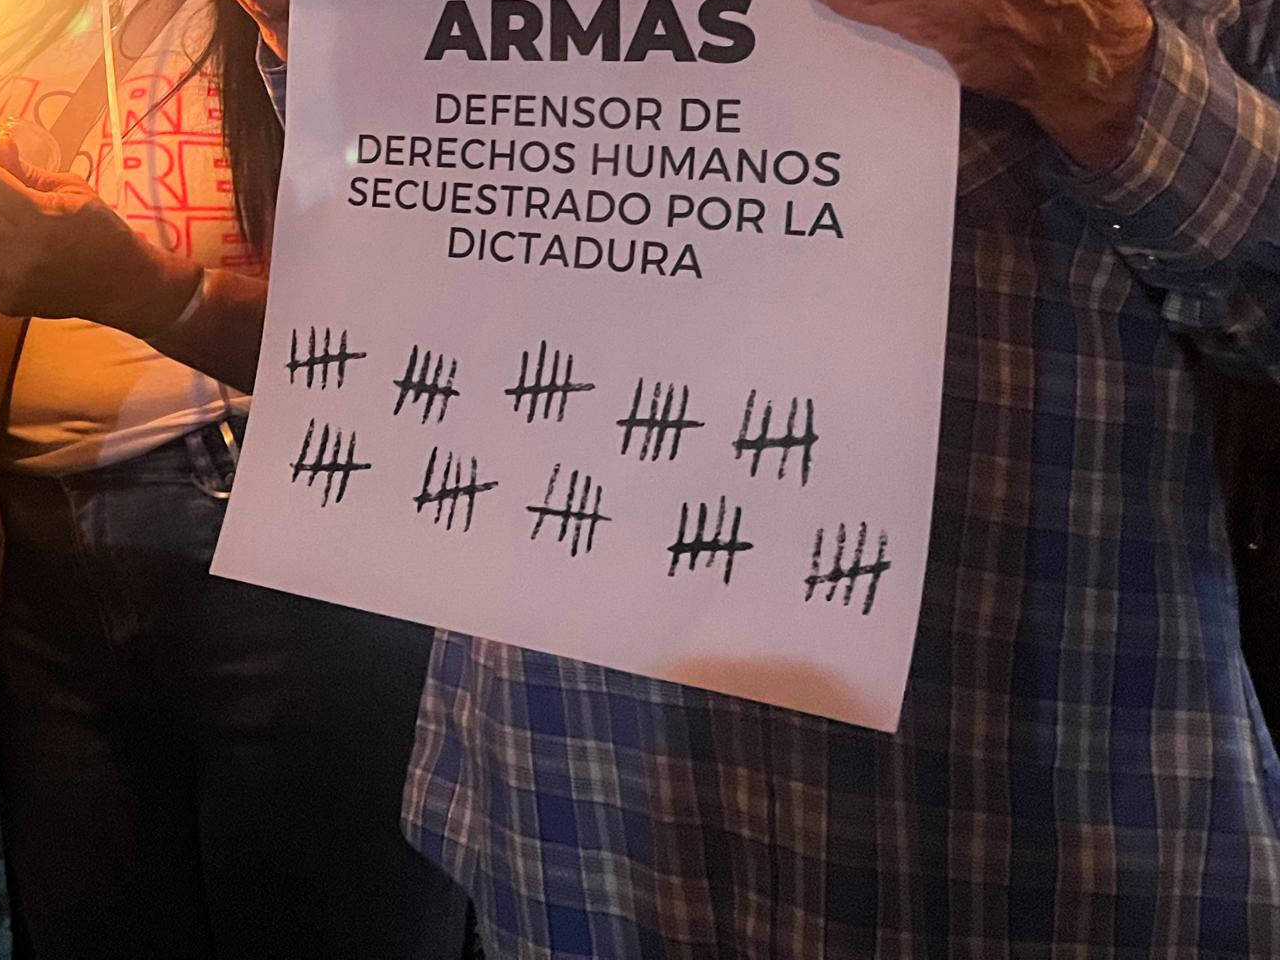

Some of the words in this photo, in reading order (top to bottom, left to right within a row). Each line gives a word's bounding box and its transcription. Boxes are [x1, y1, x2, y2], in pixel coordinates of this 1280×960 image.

[435, 93, 663, 131] DEFENSOR
[680, 98, 742, 134] DE
[356, 134, 576, 175] DERECHOS
[590, 143, 842, 187] HUMANOS
[347, 176, 652, 225] SECUESTRADO
[666, 193, 766, 234] POR
[783, 200, 845, 239] LA
[446, 227, 703, 279] DICTADURA
